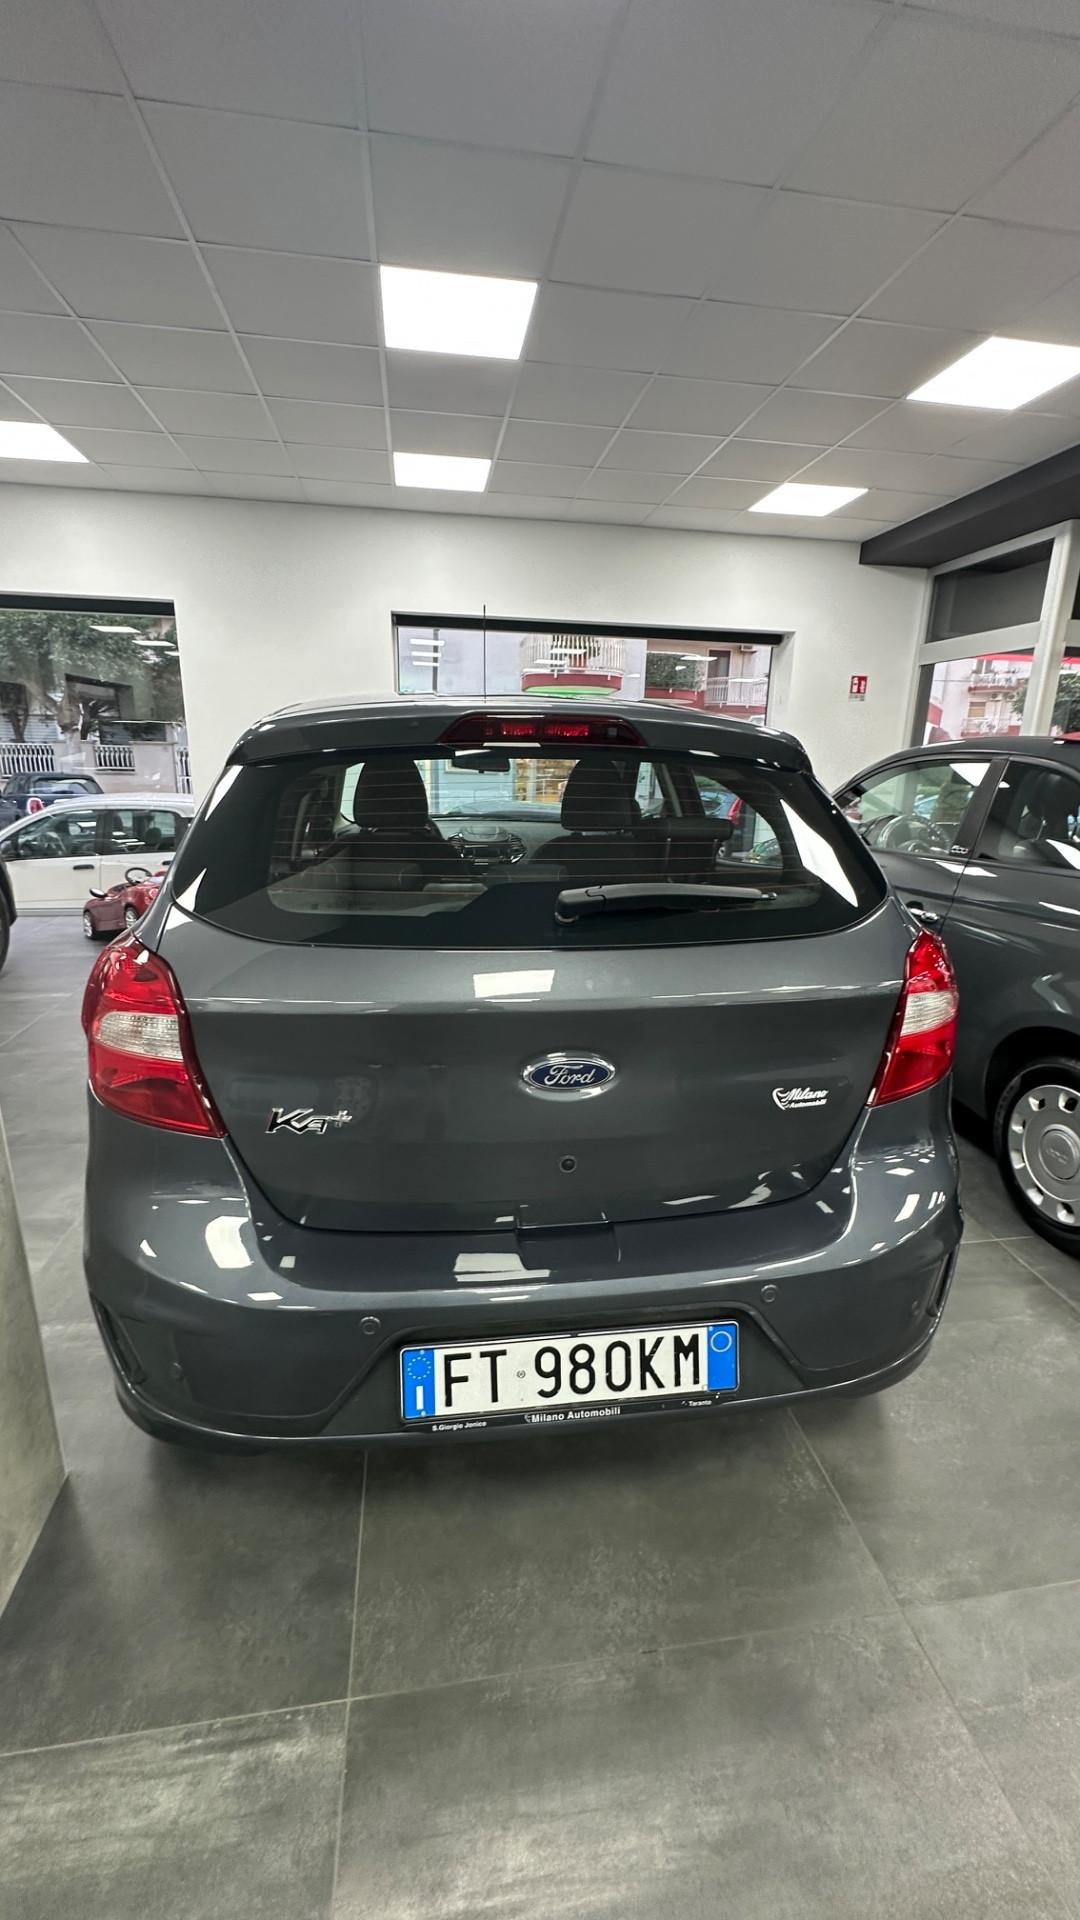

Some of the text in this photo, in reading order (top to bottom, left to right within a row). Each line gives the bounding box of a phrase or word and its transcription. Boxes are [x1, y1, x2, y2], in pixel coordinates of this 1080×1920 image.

[544, 1065, 596, 1085] Ford
[784, 1087, 829, 1101] Milano
[444, 1333, 700, 1407] FT 980KM
[531, 1406, 621, 1423] Milano Automobili
